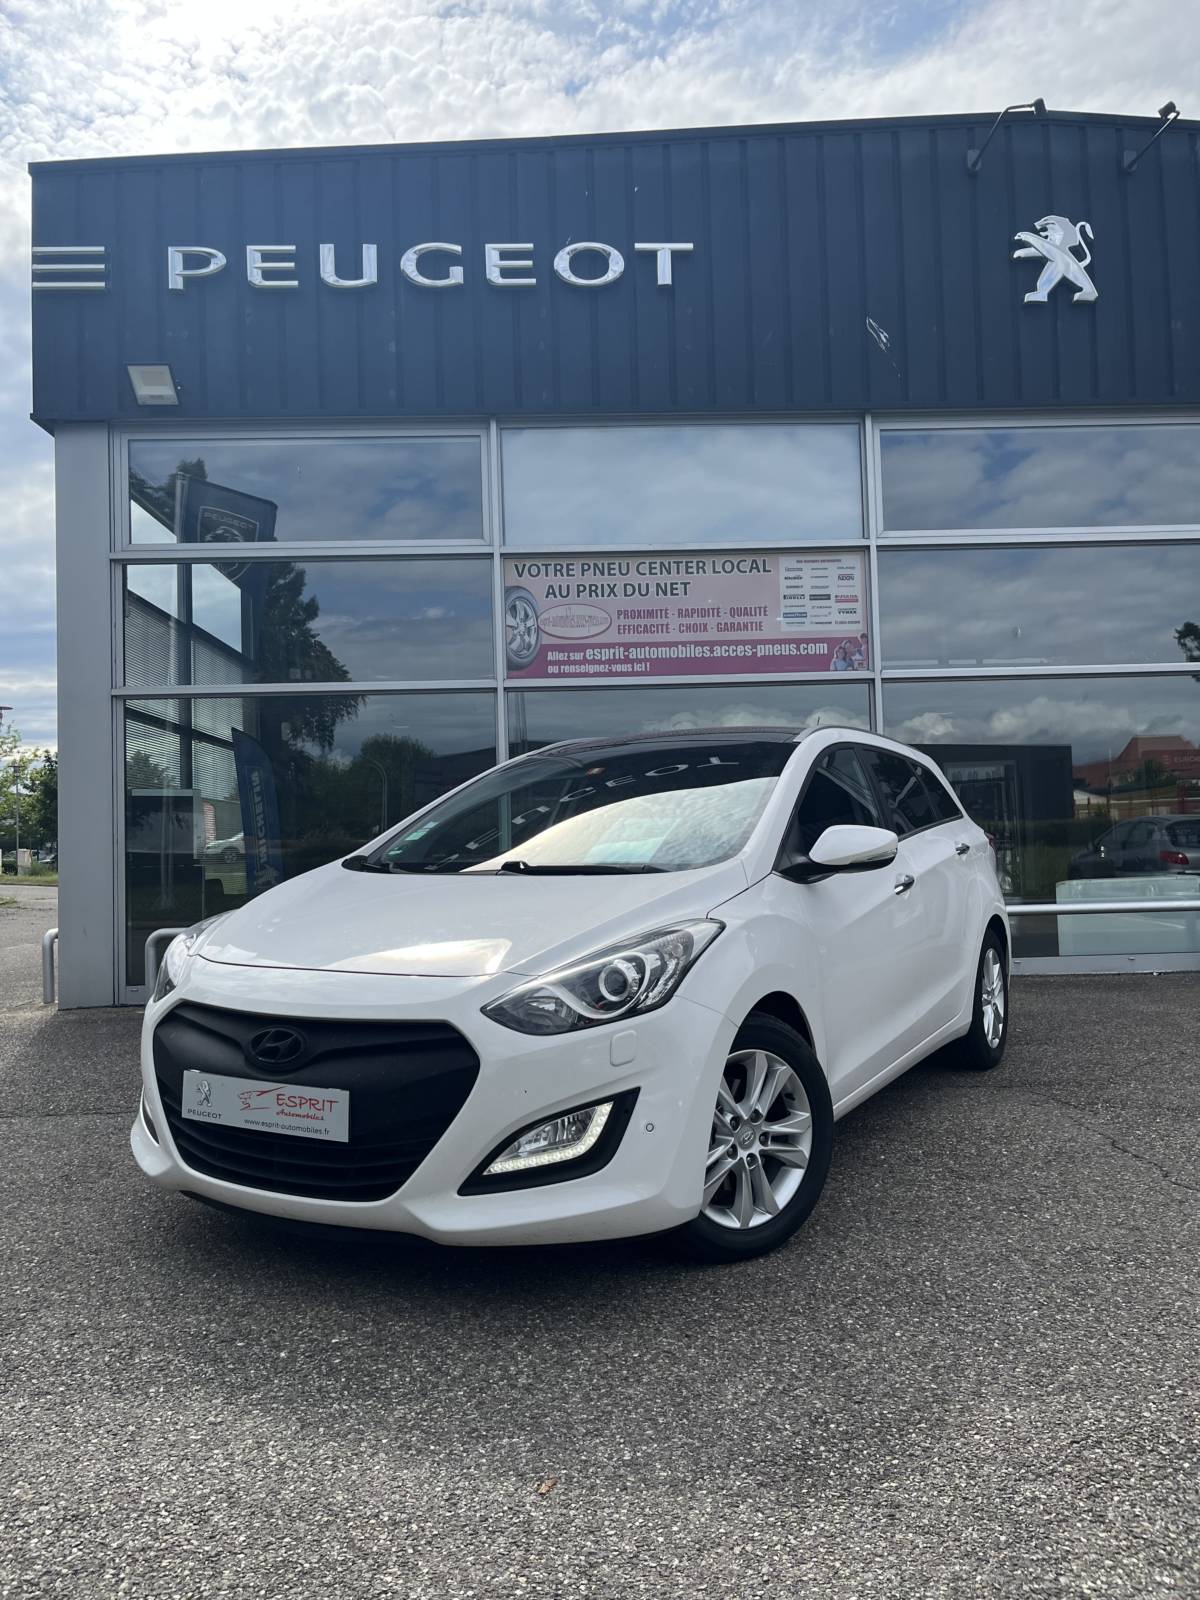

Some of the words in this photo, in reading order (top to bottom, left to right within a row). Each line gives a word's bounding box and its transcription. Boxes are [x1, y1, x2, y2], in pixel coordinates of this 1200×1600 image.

[167, 241, 694, 289] PEUGEOT
[203, 510, 255, 530] PEUGEOT
[514, 562, 576, 578] VOTRE
[581, 561, 630, 577] PNEU
[636, 560, 706, 576] CENTER
[712, 559, 771, 574] LOCAL
[545, 584, 570, 599] AU
[576, 583, 617, 598] PRIX
[623, 582, 650, 597] DU
[656, 582, 691, 597] NET
[616, 607, 669, 620] PROXIMITÉ
[677, 606, 721, 619] RAPIDITÉ
[729, 605, 768, 618] QUALITÉ
[617, 622, 670, 635] EFFICACITÉ
[678, 621, 708, 634] CHOIX
[716, 620, 763, 633] GARANTIE
[547, 651, 568, 661] Allez
[570, 653, 584, 661] sur
[586, 642, 828, 661] esprit-automobiles.acces-pneus.com
[548, 665, 559, 674] ou
[560, 662, 632, 674] renseignez-vous
[276, 1093, 339, 1113] ESPRIT
[187, 1108, 223, 1120] PEUGEOT
[276, 1109, 325, 1121] Automobiles
[244, 1118, 330, 1136] www.esprit-automobiles.fr
